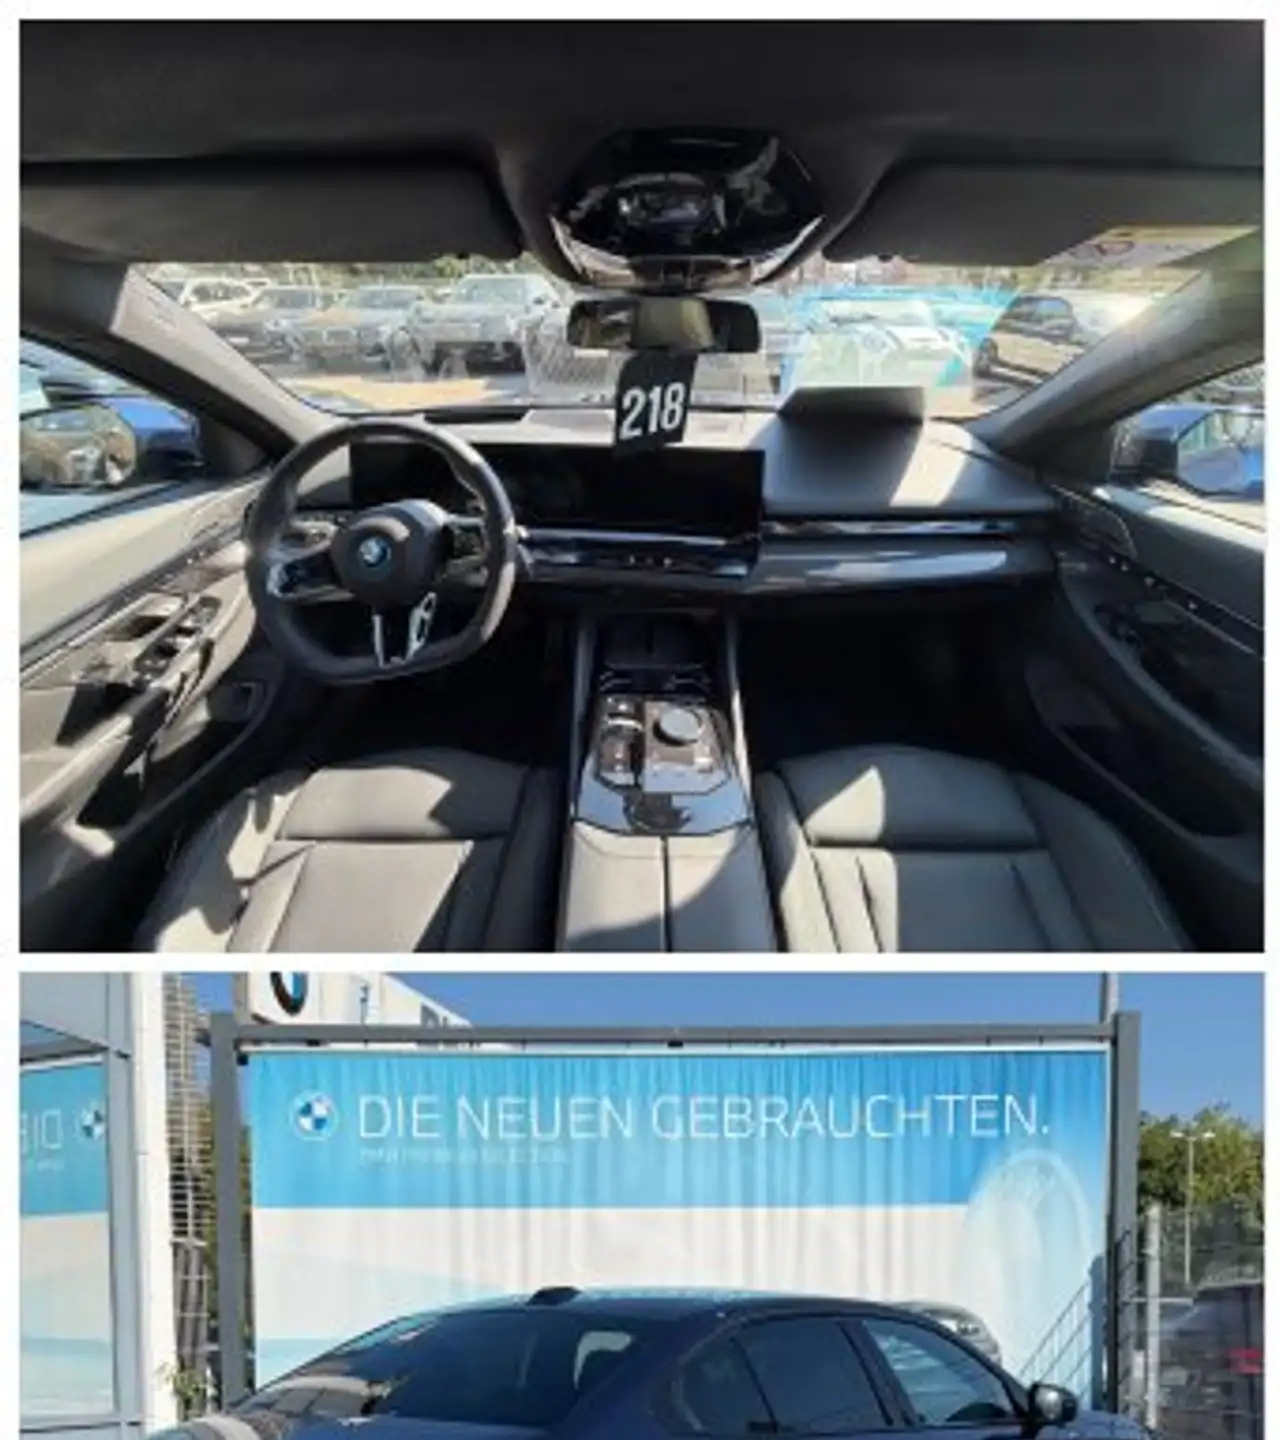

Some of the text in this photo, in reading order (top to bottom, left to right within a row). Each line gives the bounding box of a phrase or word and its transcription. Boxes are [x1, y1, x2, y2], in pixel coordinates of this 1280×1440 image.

[620, 381, 685, 440] 218
[359, 1093, 1051, 1141] DIE NEUEN GEBRAUCHTEN.
